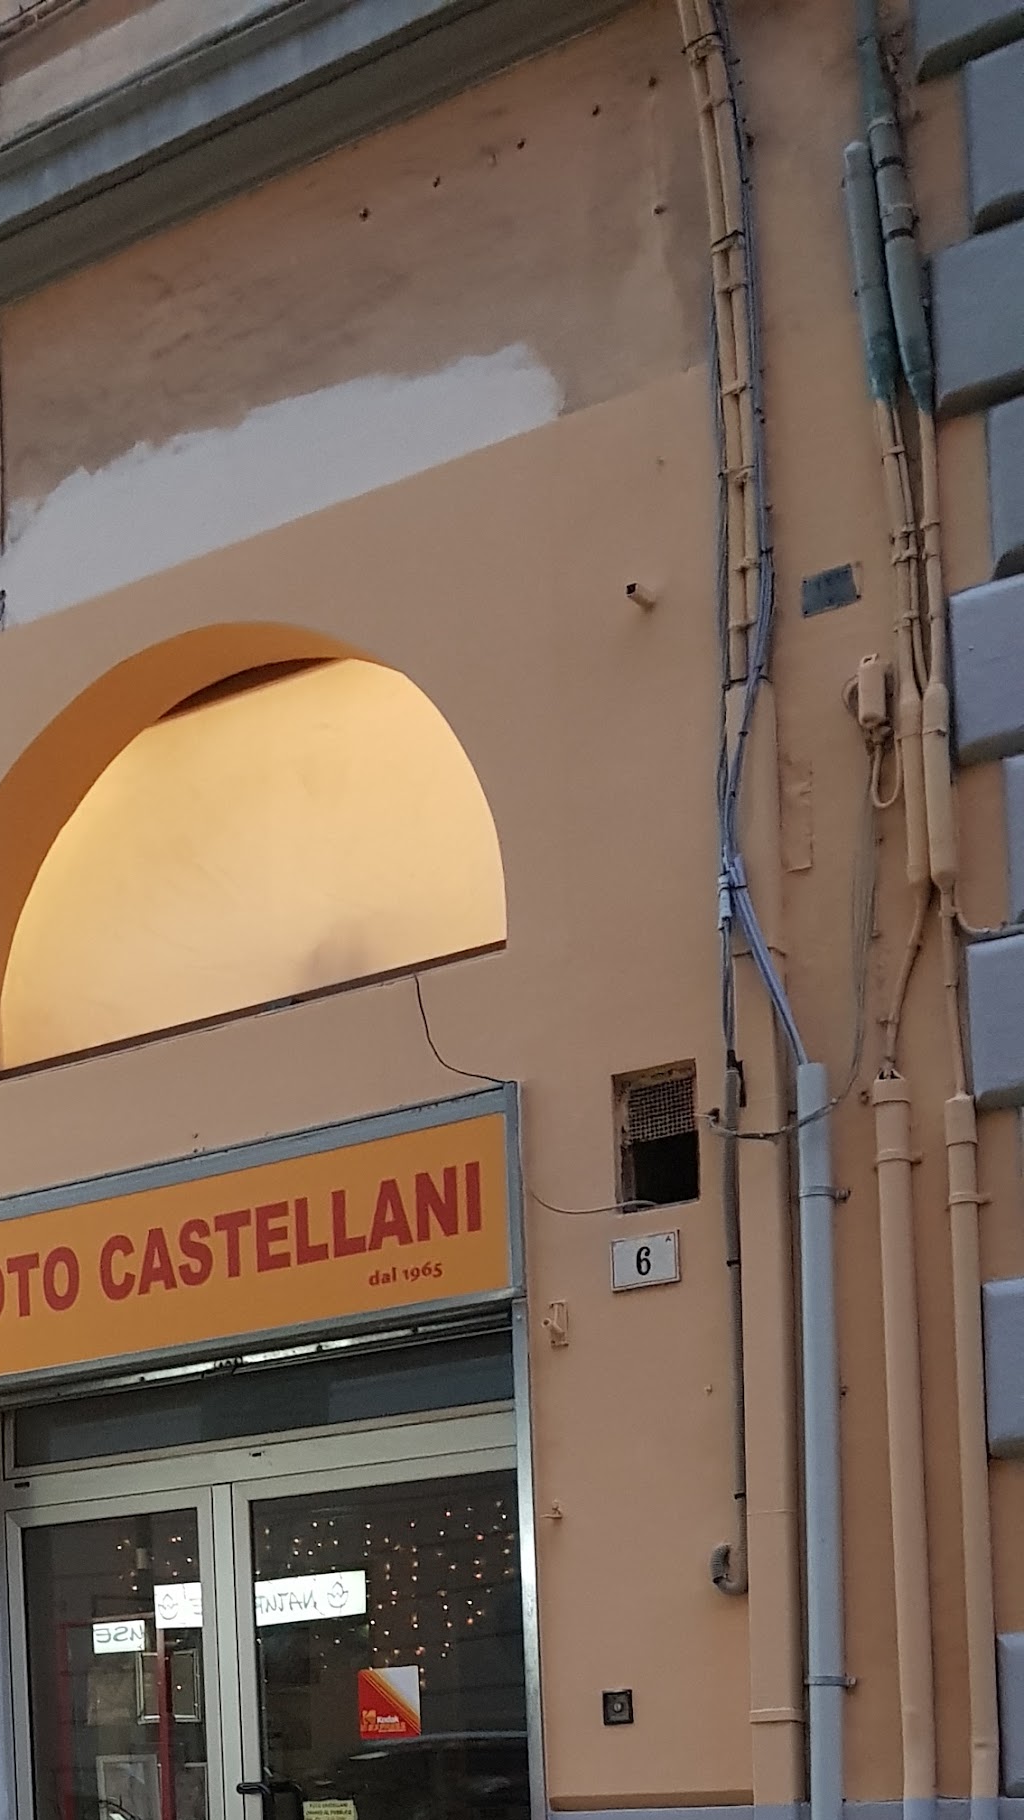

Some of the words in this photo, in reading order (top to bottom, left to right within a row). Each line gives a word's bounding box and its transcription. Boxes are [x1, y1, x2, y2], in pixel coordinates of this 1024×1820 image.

[99, 1161, 482, 1301] CASTELLANI
[368, 1267, 397, 1286] dal
[403, 1261, 443, 1282] 1965
[636, 1246, 651, 1276] 6
